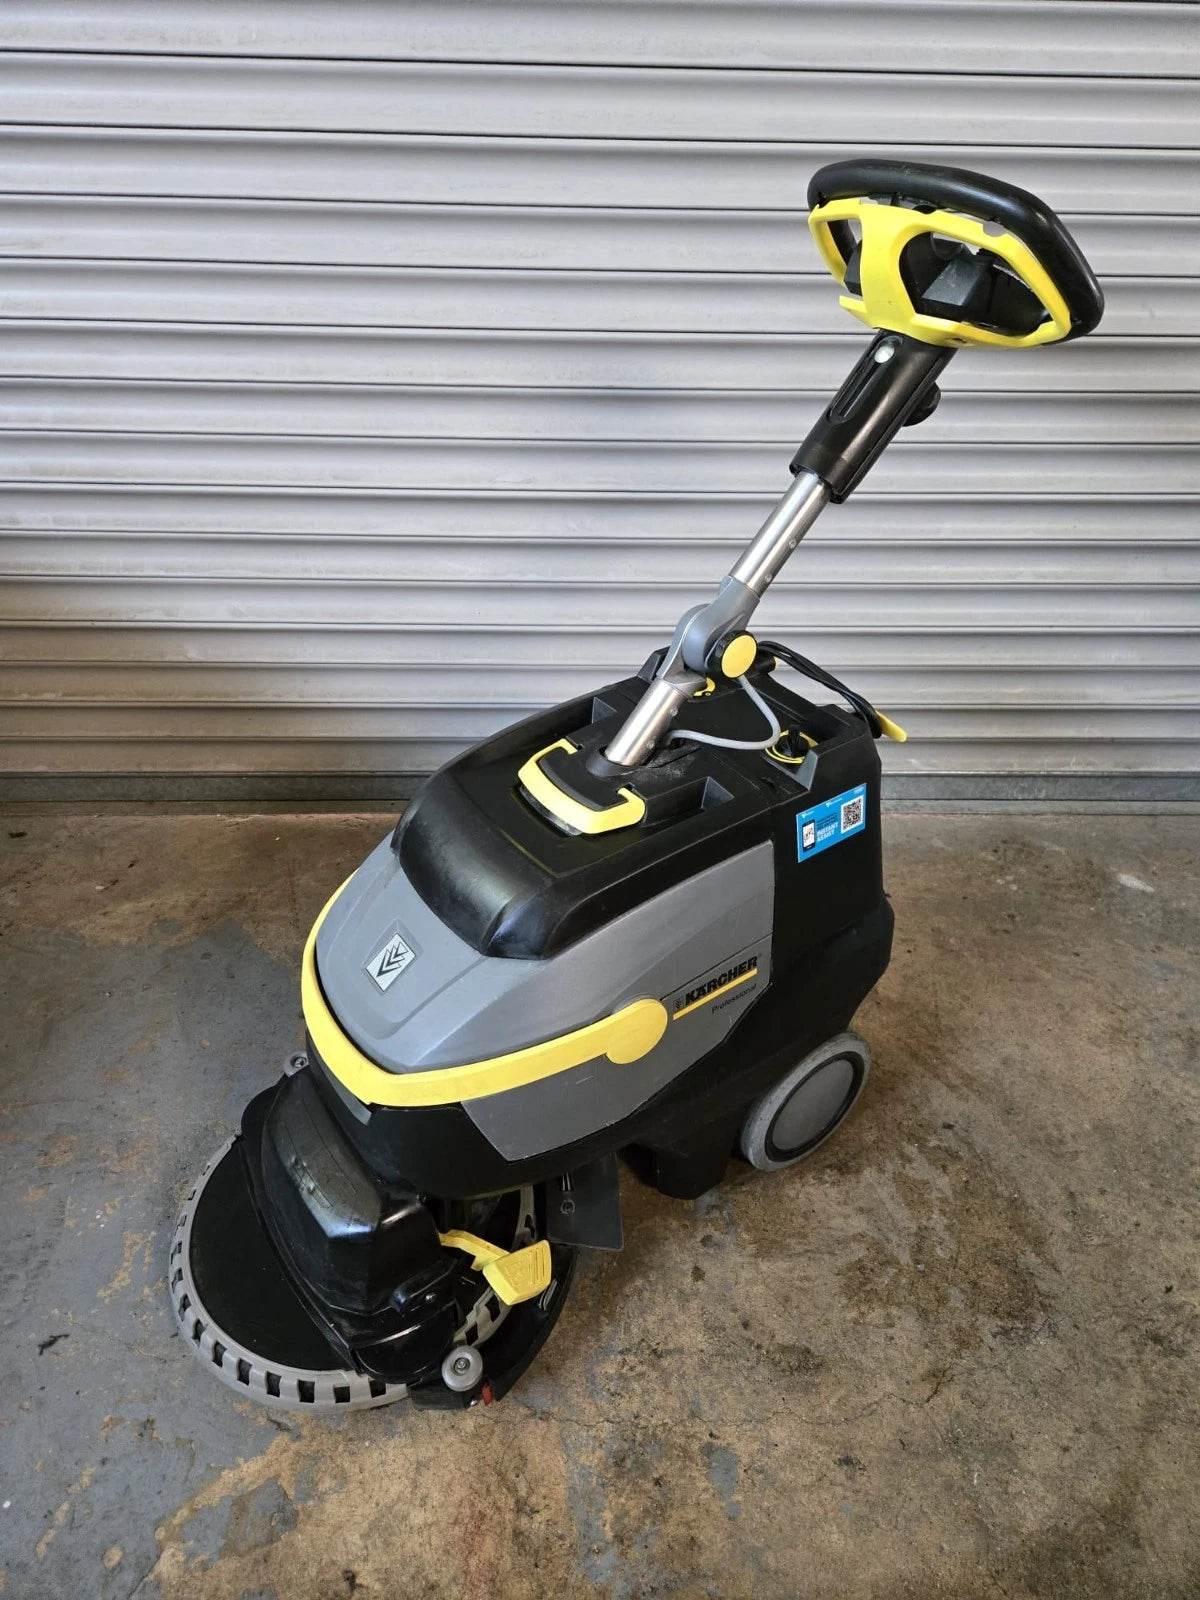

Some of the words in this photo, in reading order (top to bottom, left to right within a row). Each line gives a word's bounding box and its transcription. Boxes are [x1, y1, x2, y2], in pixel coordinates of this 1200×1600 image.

[816, 822, 839, 837] INSTANT
[816, 830, 835, 842] ASSIST
[685, 956, 758, 1006] KÄRCHER
[711, 983, 757, 1014] Professional
